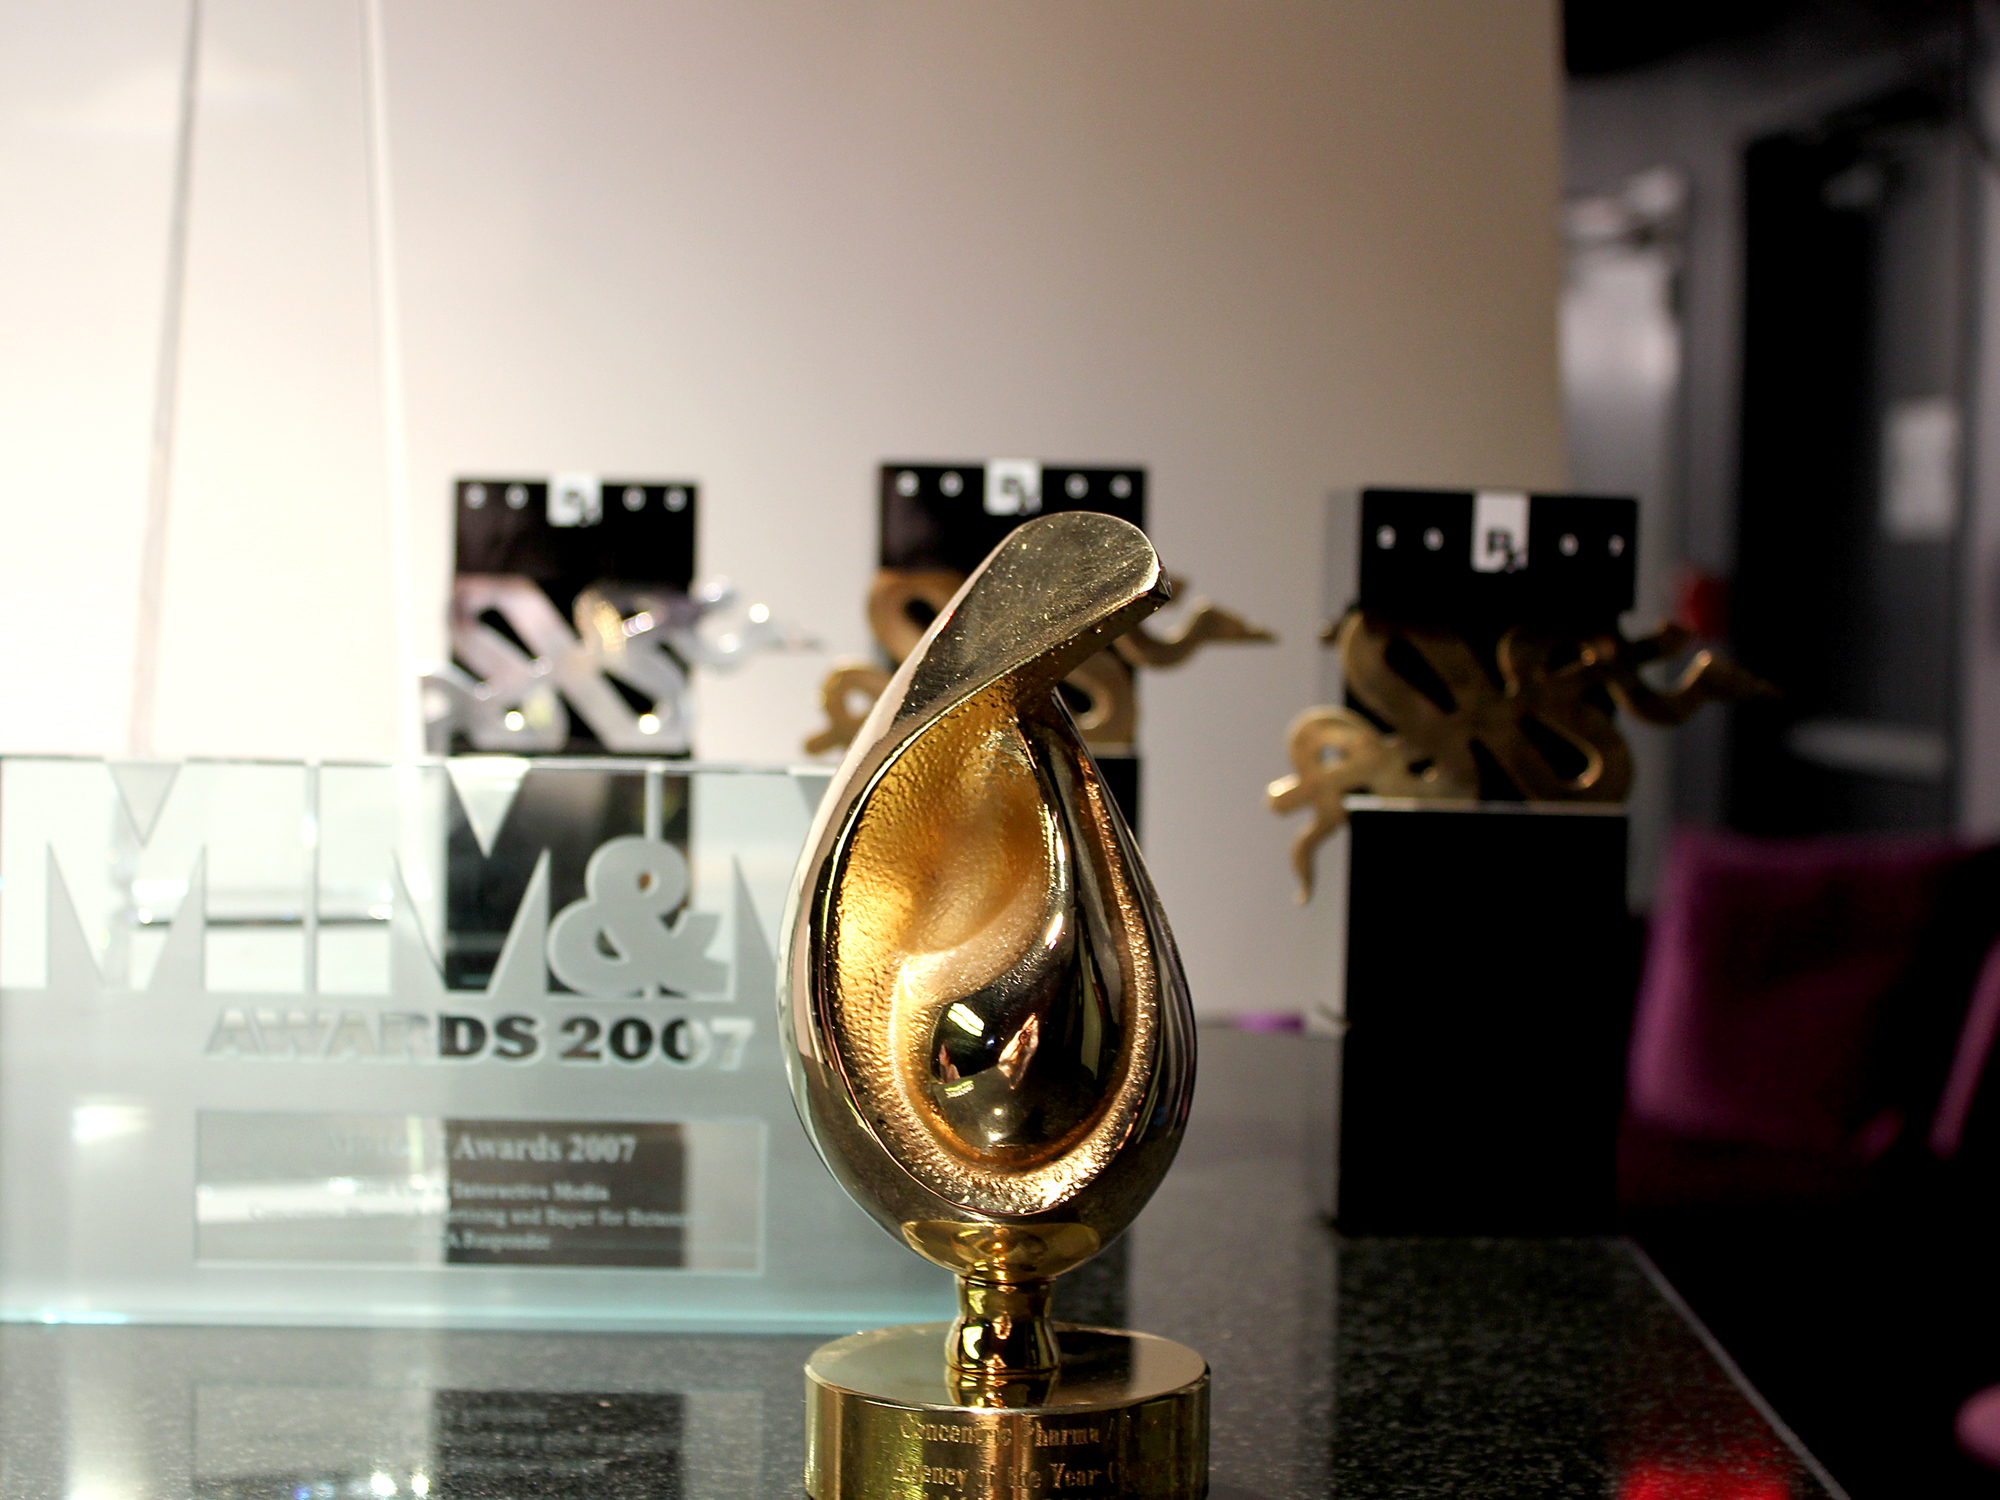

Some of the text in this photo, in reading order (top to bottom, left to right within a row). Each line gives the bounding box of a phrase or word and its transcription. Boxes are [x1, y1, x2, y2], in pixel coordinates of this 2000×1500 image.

[204, 1008, 753, 1069] AWARDS 2007
[452, 1133, 562, 1161] Awards
[567, 1133, 637, 1164] 2007
[1049, 1462, 1102, 1489] Year
